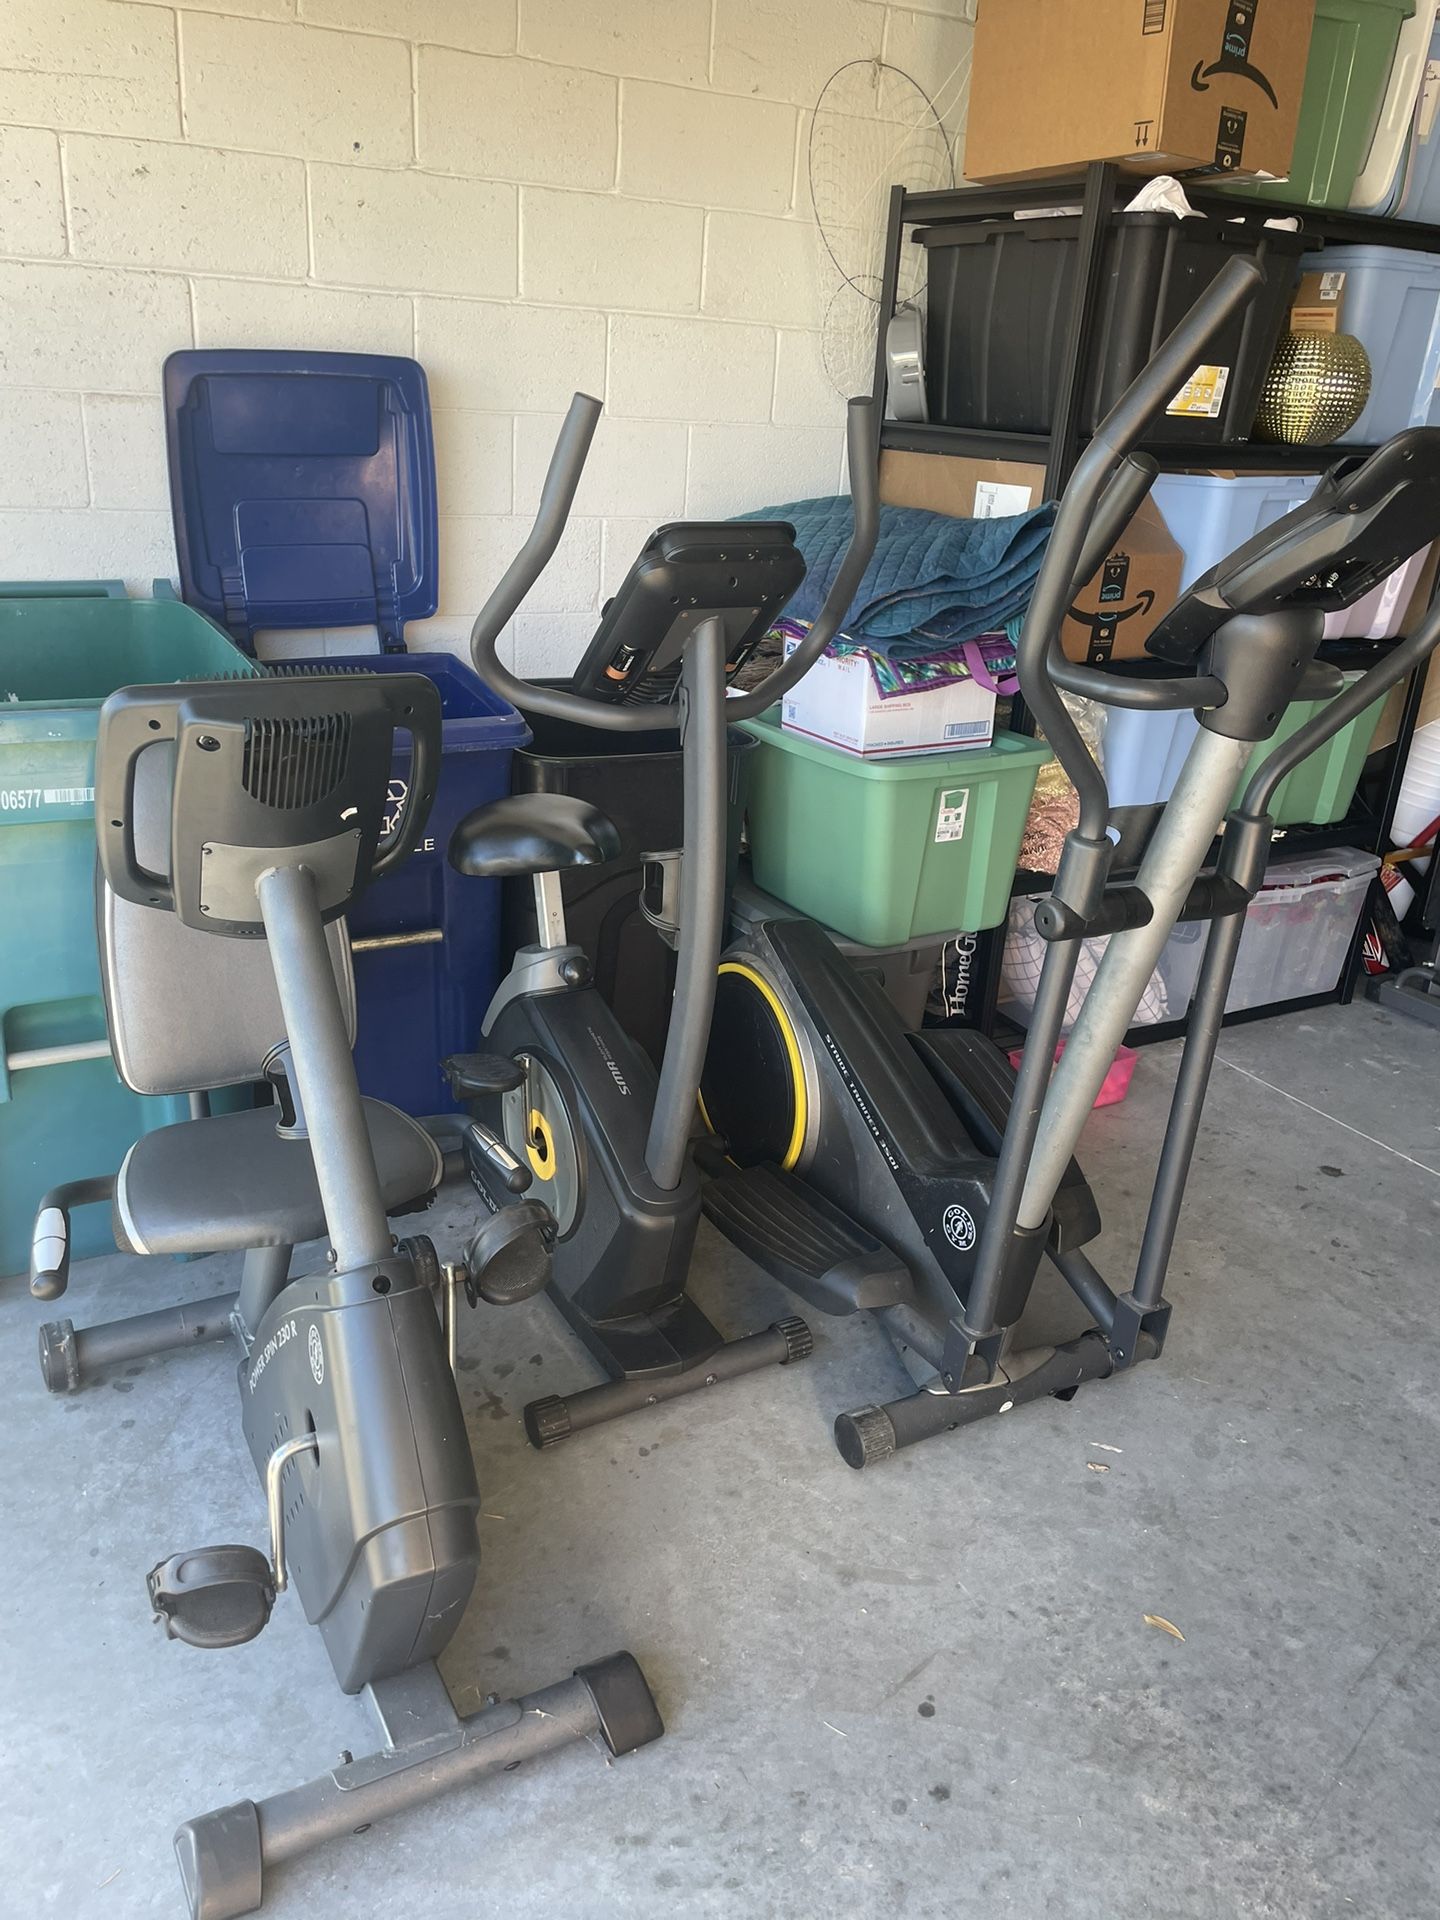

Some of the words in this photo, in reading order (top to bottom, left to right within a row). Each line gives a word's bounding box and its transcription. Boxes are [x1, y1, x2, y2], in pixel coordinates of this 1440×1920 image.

[1224, 42, 1247, 58] prime
[1, 789, 42, 811] 06577
[606, 1061, 632, 1096] SMR
[825, 1033, 850, 1079] STRIDE
[849, 1082, 880, 1137] TRAINER
[249, 1354, 266, 1395] POWER
[263, 1336, 278, 1364] SPIN
[277, 1323, 291, 1348] 230
[290, 1319, 298, 1338] R
